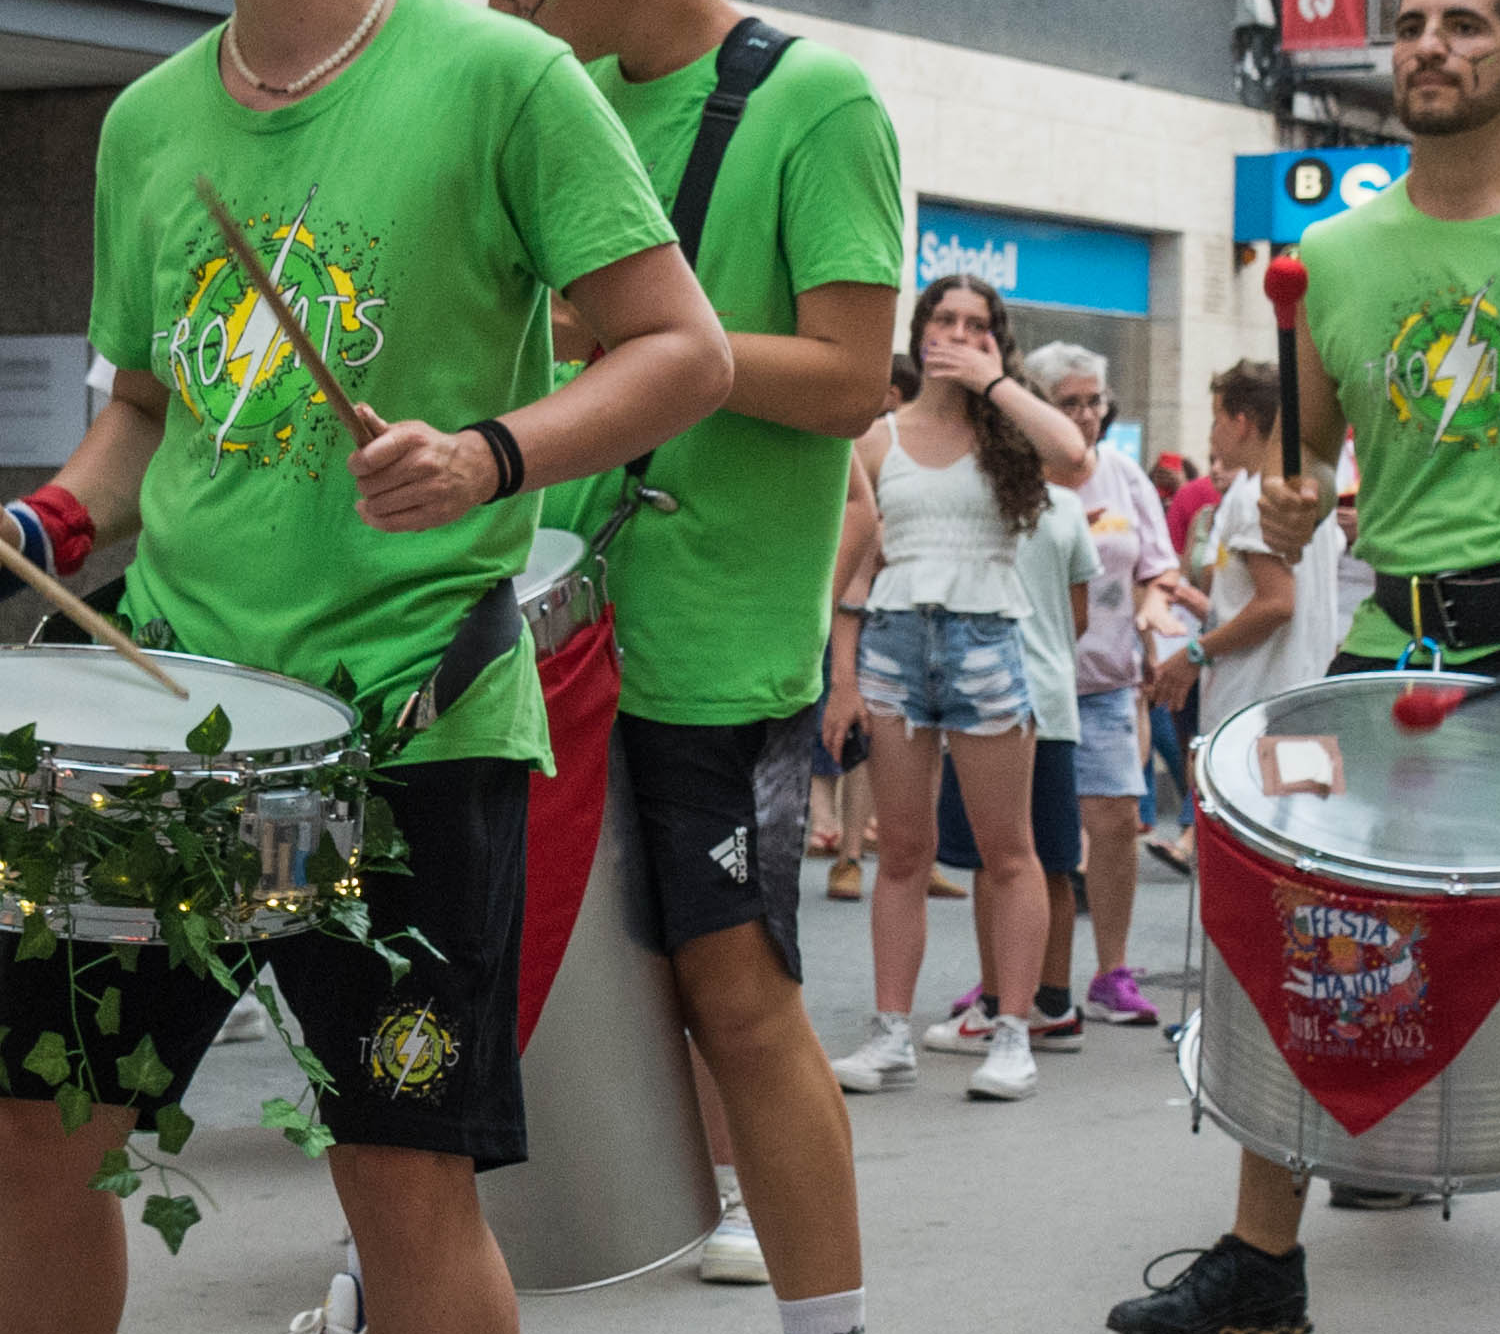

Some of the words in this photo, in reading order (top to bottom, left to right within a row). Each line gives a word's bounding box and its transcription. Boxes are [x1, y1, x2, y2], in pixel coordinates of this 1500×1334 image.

[1295, 164, 1323, 200] B
[919, 229, 1018, 293] Sabadell
[1310, 906, 1390, 947] FESTA
[1312, 964, 1391, 1001] MAJOR
